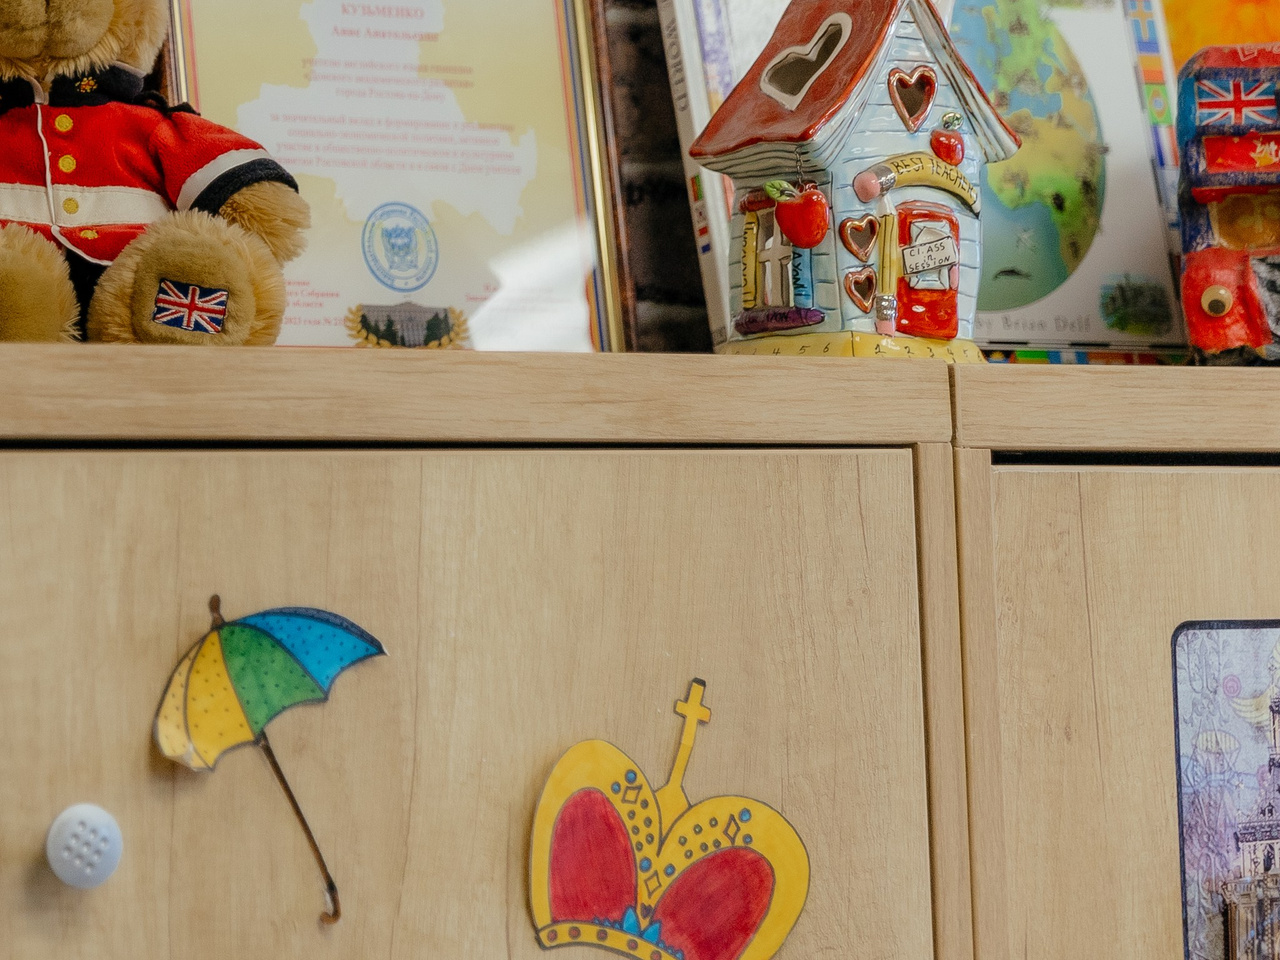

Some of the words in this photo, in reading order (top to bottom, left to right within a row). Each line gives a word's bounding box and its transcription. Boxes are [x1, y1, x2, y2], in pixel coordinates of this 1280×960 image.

[908, 256, 951, 273] SESSION
[799, 346, 810, 355] 5
[823, 342, 831, 354] 6
